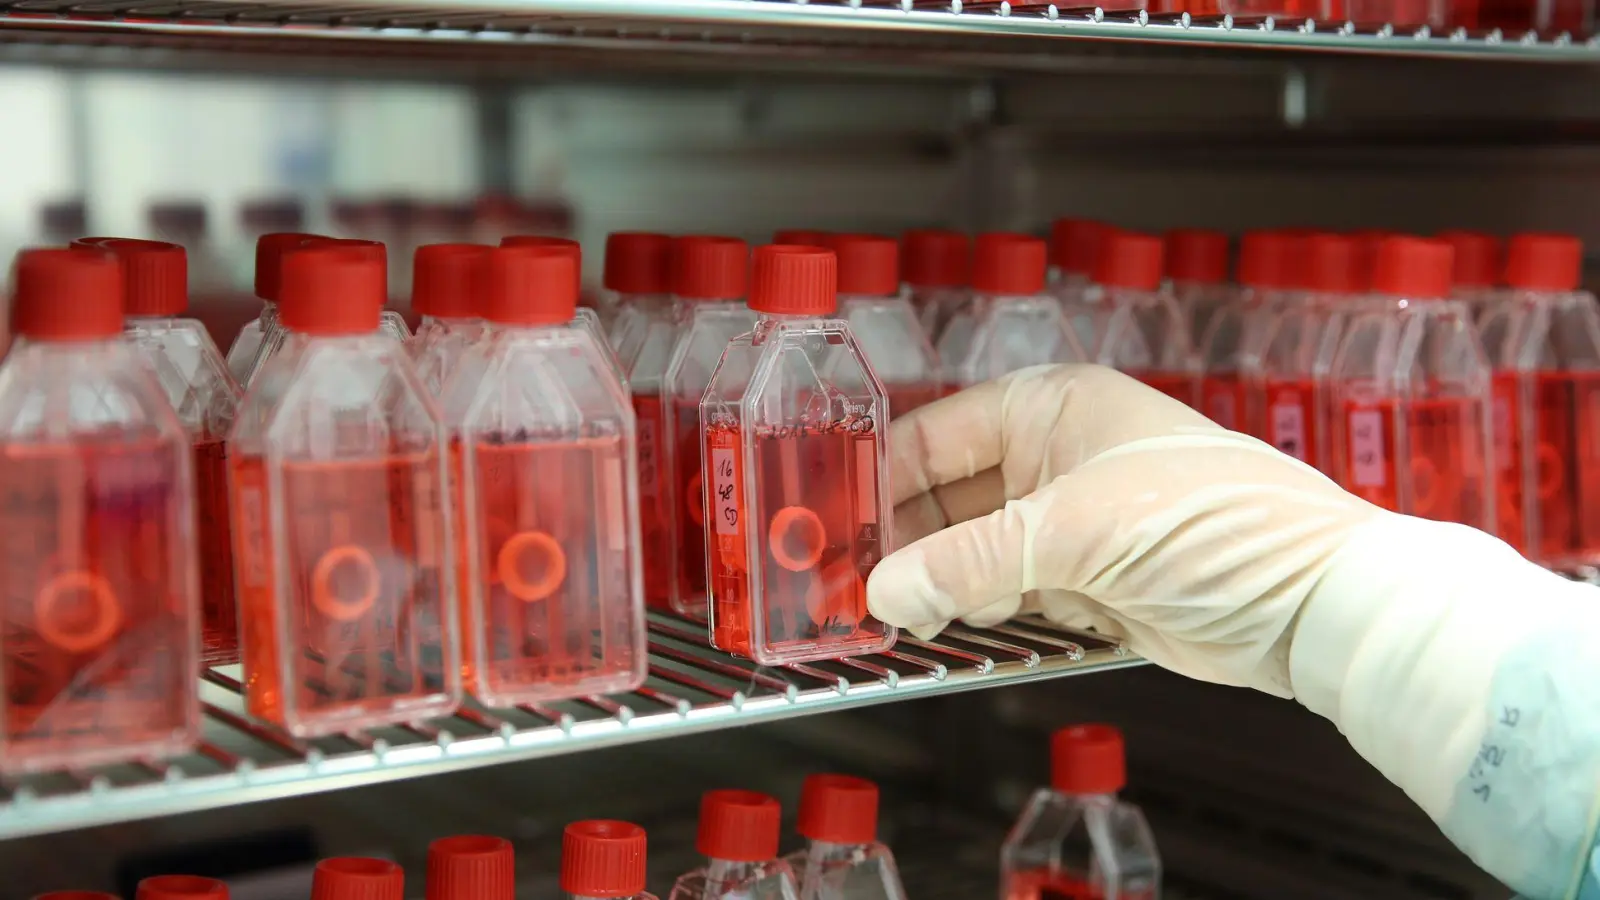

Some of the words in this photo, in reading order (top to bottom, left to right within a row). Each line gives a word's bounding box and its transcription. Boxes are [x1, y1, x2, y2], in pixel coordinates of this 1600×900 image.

[717, 459, 732, 477] 16
[718, 484, 733, 501] 48
[724, 507, 738, 526] CD
